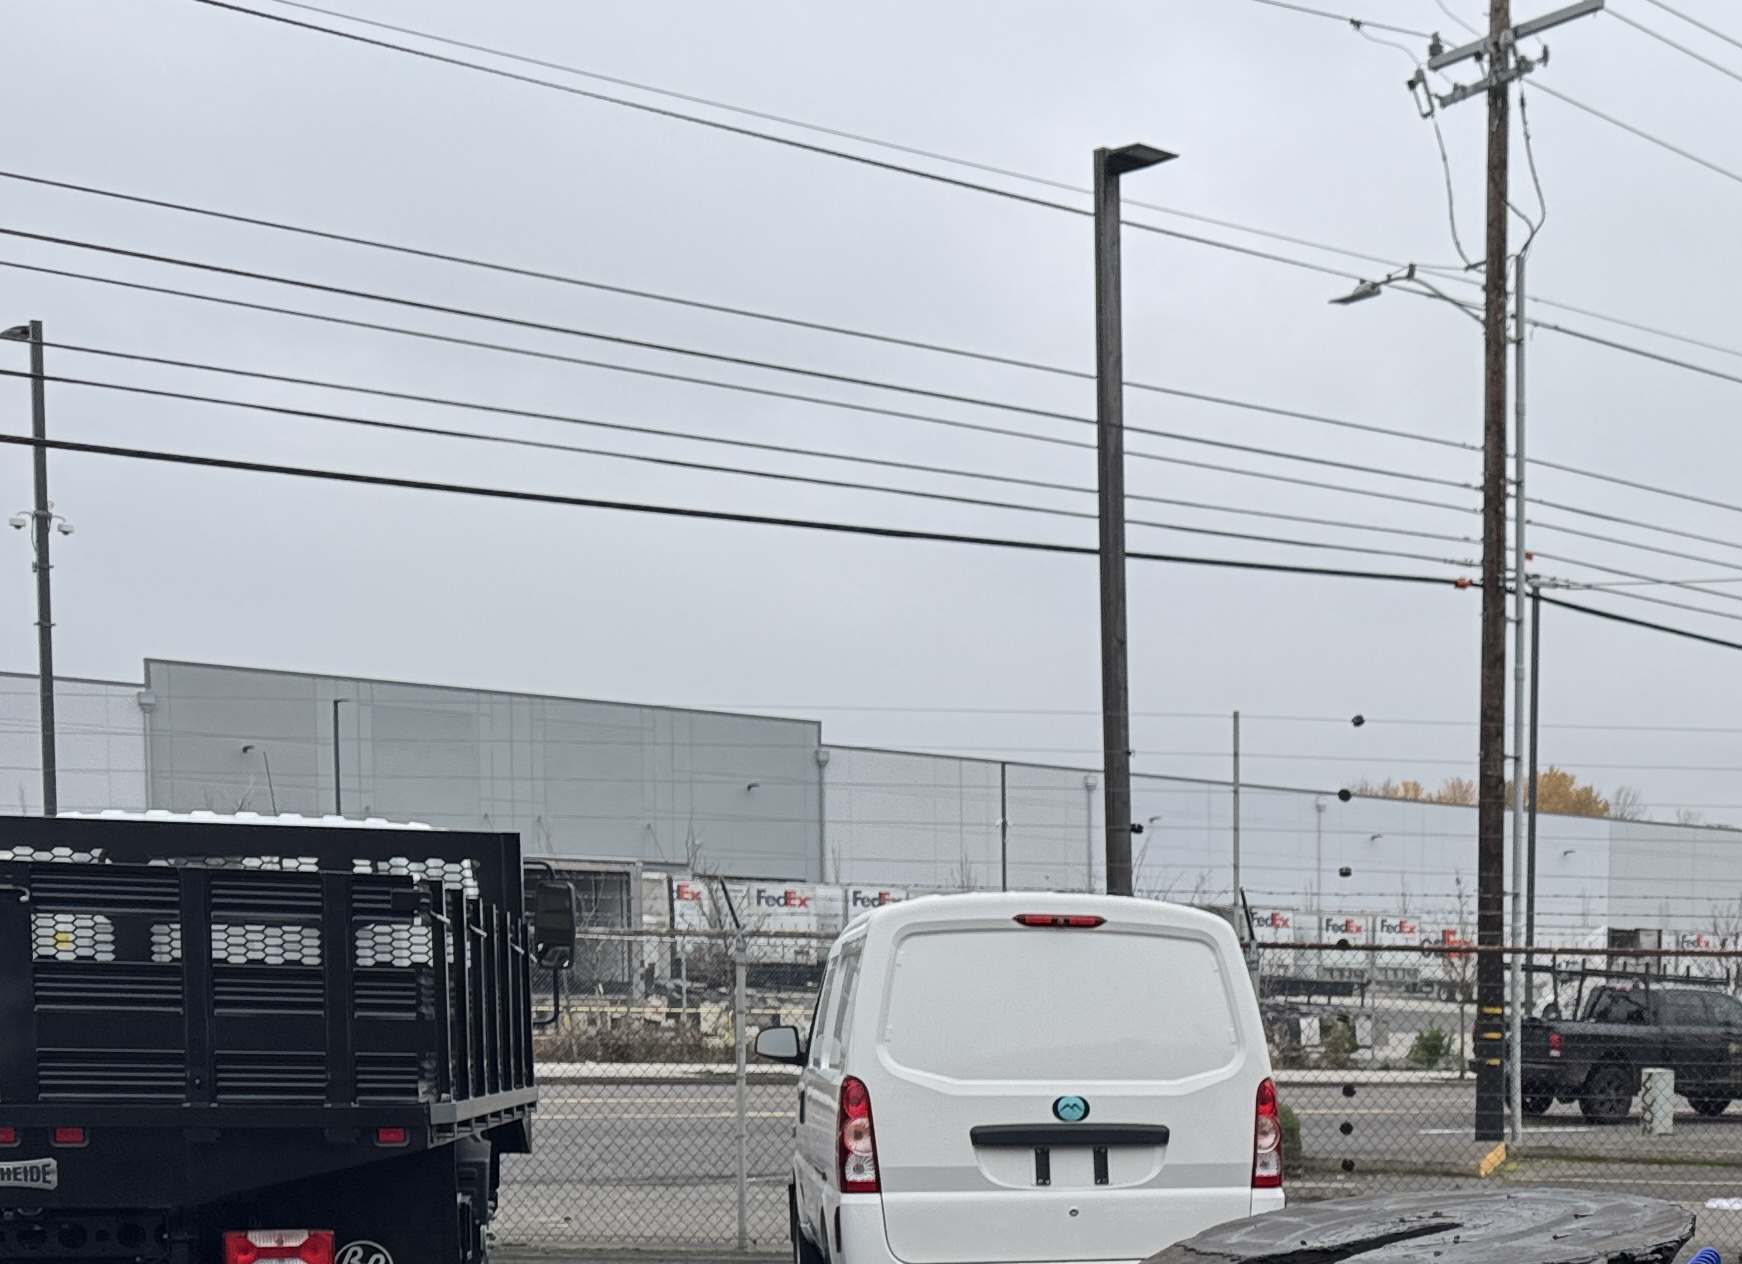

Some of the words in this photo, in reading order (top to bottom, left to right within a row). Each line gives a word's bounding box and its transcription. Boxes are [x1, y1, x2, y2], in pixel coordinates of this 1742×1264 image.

[756, 888, 809, 908] FedEx
[1250, 911, 1290, 928] FedEx
[1325, 918, 1363, 934] FedEx
[1381, 918, 1416, 934] FedEx
[0, 1164, 52, 1185] HEIDE
